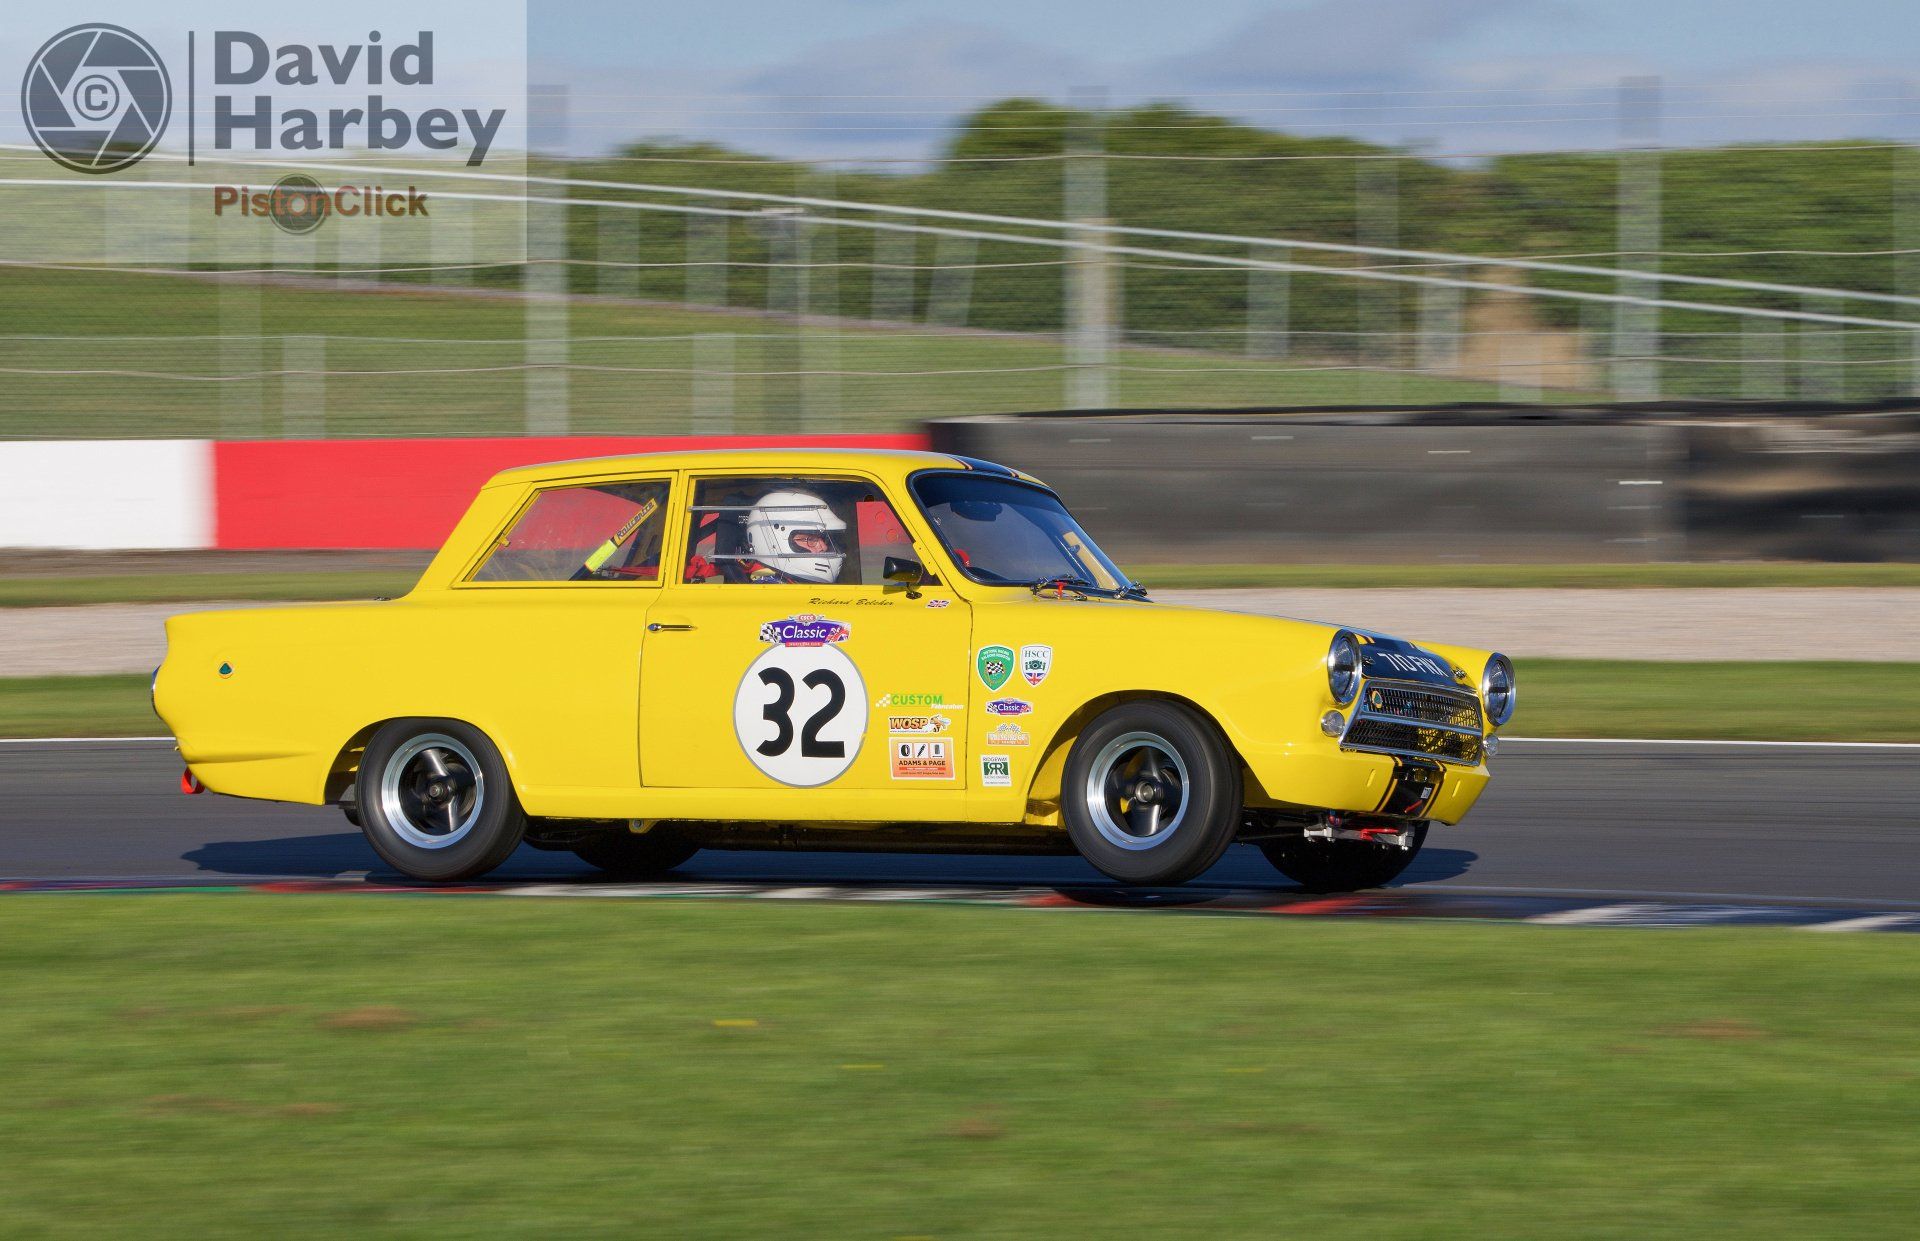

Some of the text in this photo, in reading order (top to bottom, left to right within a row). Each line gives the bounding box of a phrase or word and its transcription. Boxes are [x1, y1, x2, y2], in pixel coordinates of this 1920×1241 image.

[808, 597, 852, 606] Richard
[782, 625, 827, 639] Classic
[1024, 650, 1050, 659] HSCC
[892, 695, 943, 706] CUSTOM
[756, 666, 846, 758] 32
[997, 703, 1020, 711] Classic
[889, 717, 929, 730] WOSP
